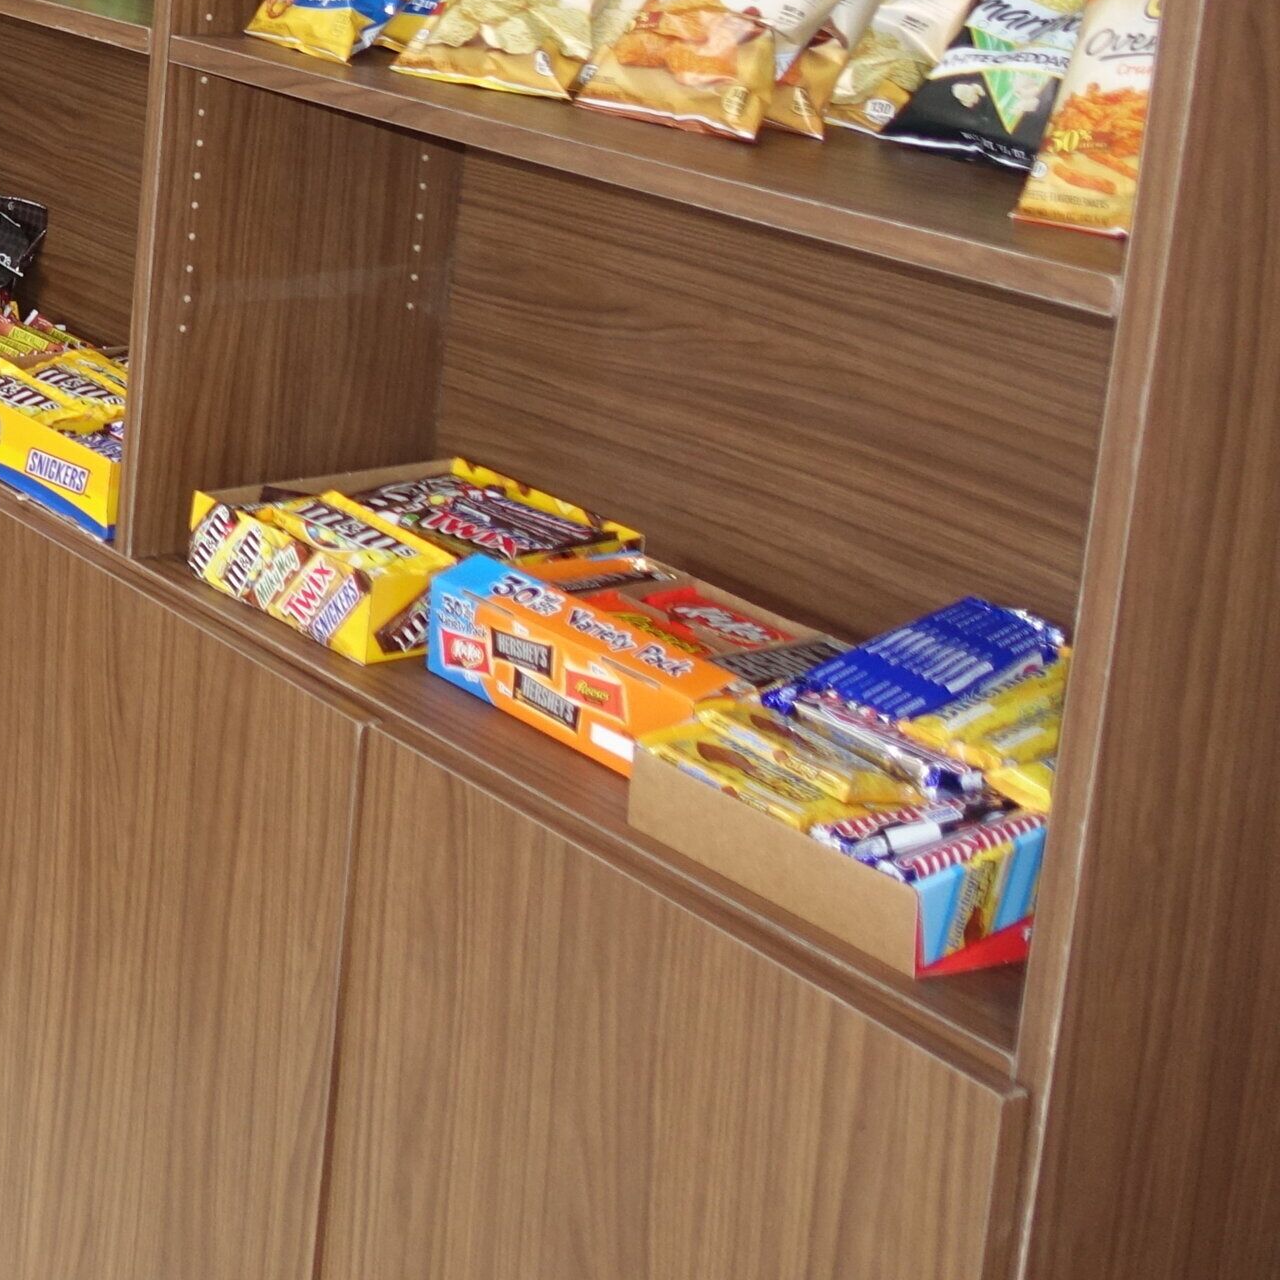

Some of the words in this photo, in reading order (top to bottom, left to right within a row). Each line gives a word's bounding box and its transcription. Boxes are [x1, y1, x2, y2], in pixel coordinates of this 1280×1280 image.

[28, 451, 86, 493] SNICKERS
[312, 578, 360, 643] SNICKERS
[492, 575, 542, 605] 30
[570, 607, 635, 651] Variety
[636, 643, 694, 677] Pack
[496, 630, 549, 668] HERSHEY'S
[522, 674, 575, 724] HERSHEY'S
